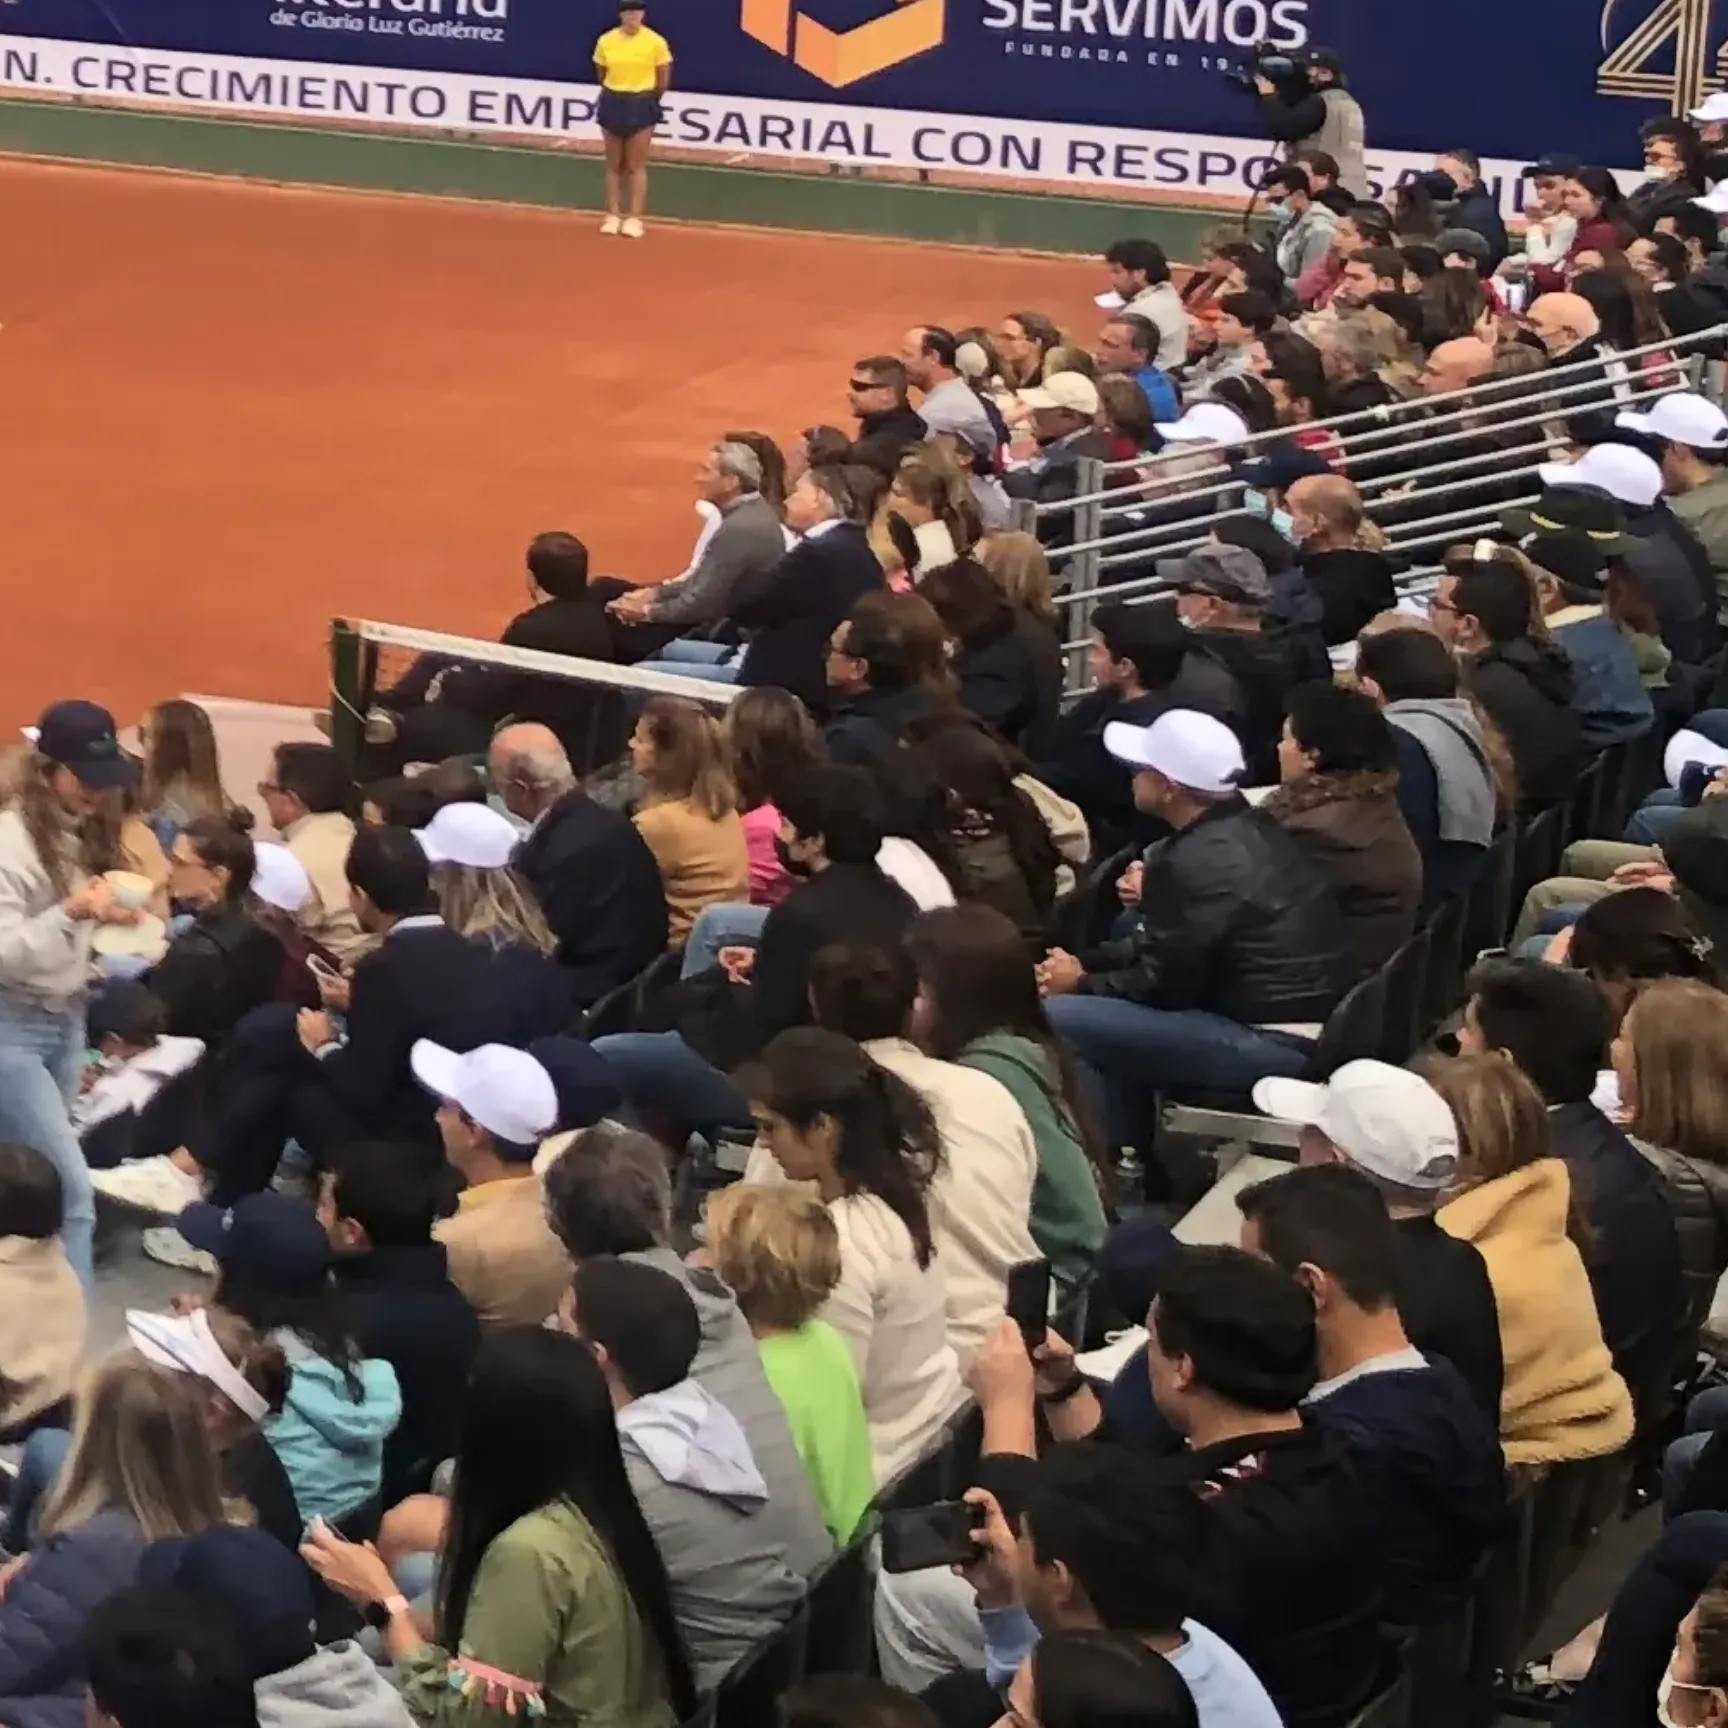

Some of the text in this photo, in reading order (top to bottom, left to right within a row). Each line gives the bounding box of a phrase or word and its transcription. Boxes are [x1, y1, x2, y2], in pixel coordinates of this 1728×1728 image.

[269, 8, 505, 43] de Gloria Luz Gutiérrez
[1147, 51, 1179, 67] EN
[72, 55, 445, 119] CRECIMIENTO
[468, 90, 891, 158] EMPESARIAL
[912, 126, 1041, 171] CON
